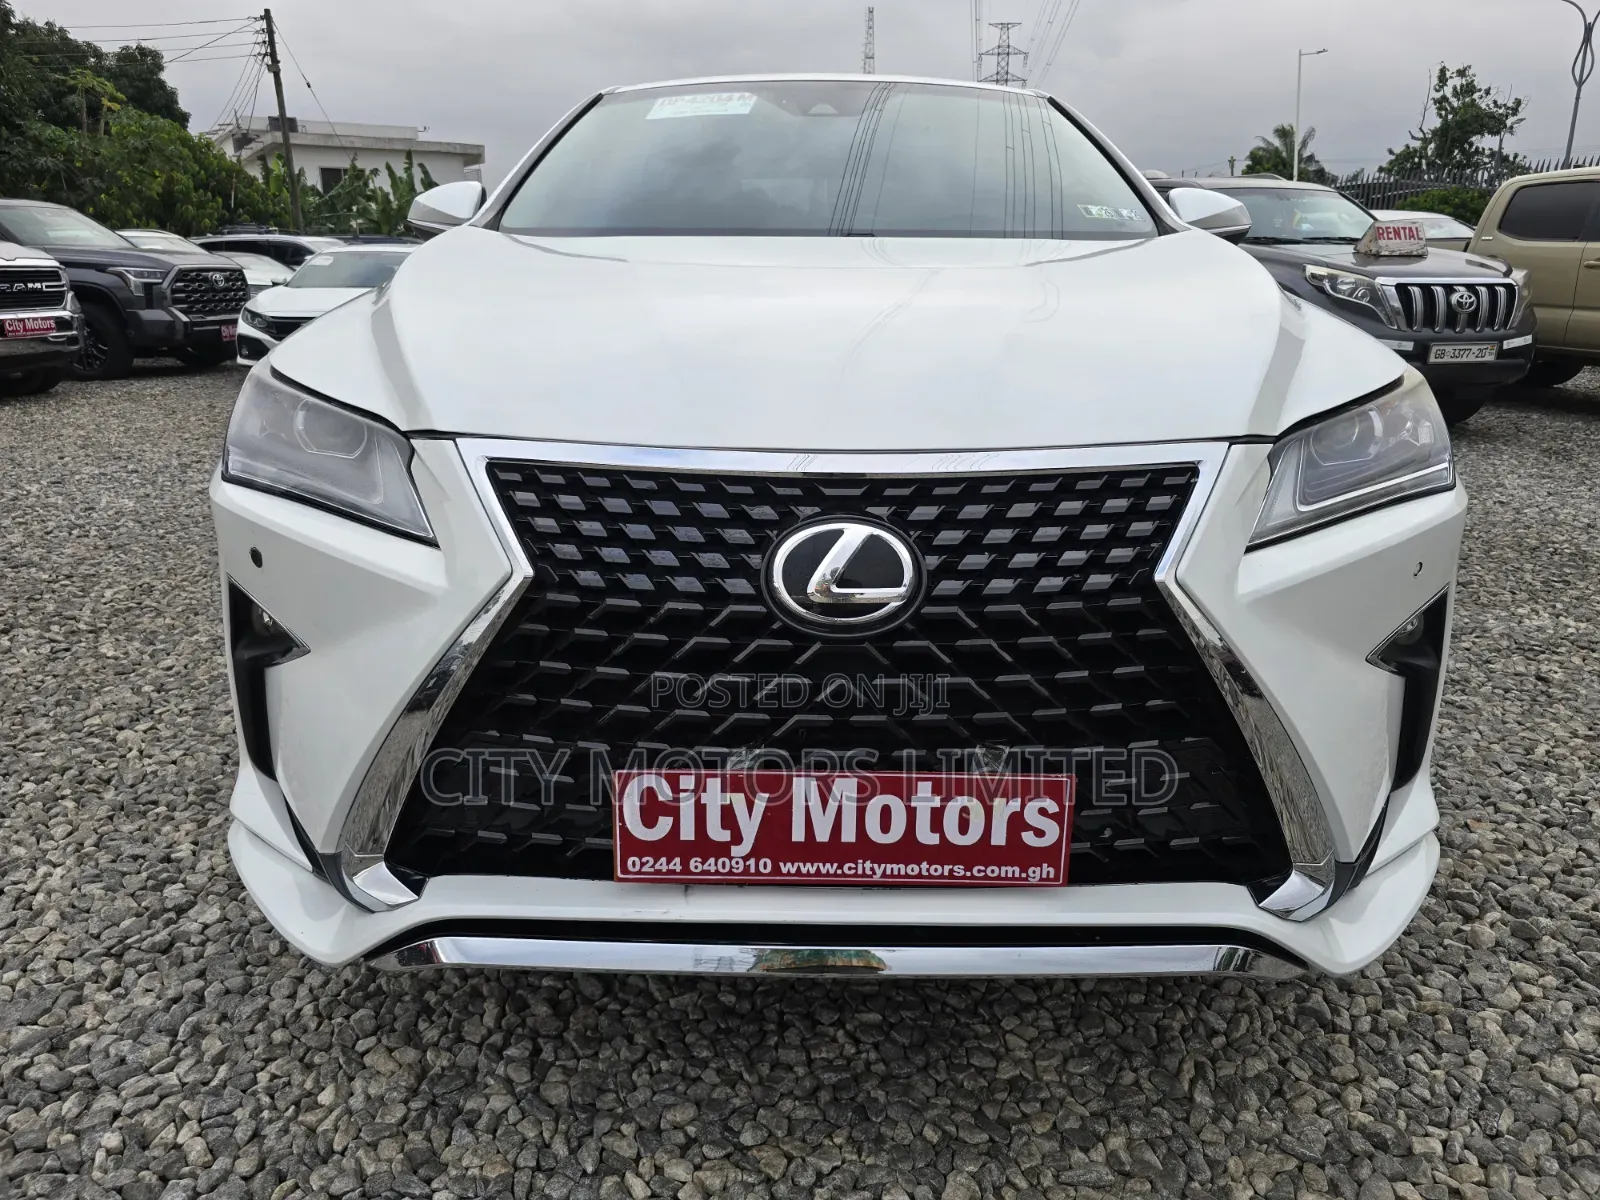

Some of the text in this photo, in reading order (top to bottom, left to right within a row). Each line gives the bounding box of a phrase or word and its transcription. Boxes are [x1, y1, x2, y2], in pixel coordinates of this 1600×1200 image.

[1375, 226, 1424, 241] RENTAL
[6, 318, 56, 333] City Motors
[1434, 348, 1446, 360] GB
[622, 774, 1061, 857] City Motors
[627, 856, 1055, 882] 0244 640910 www.citymotors.com.gh
